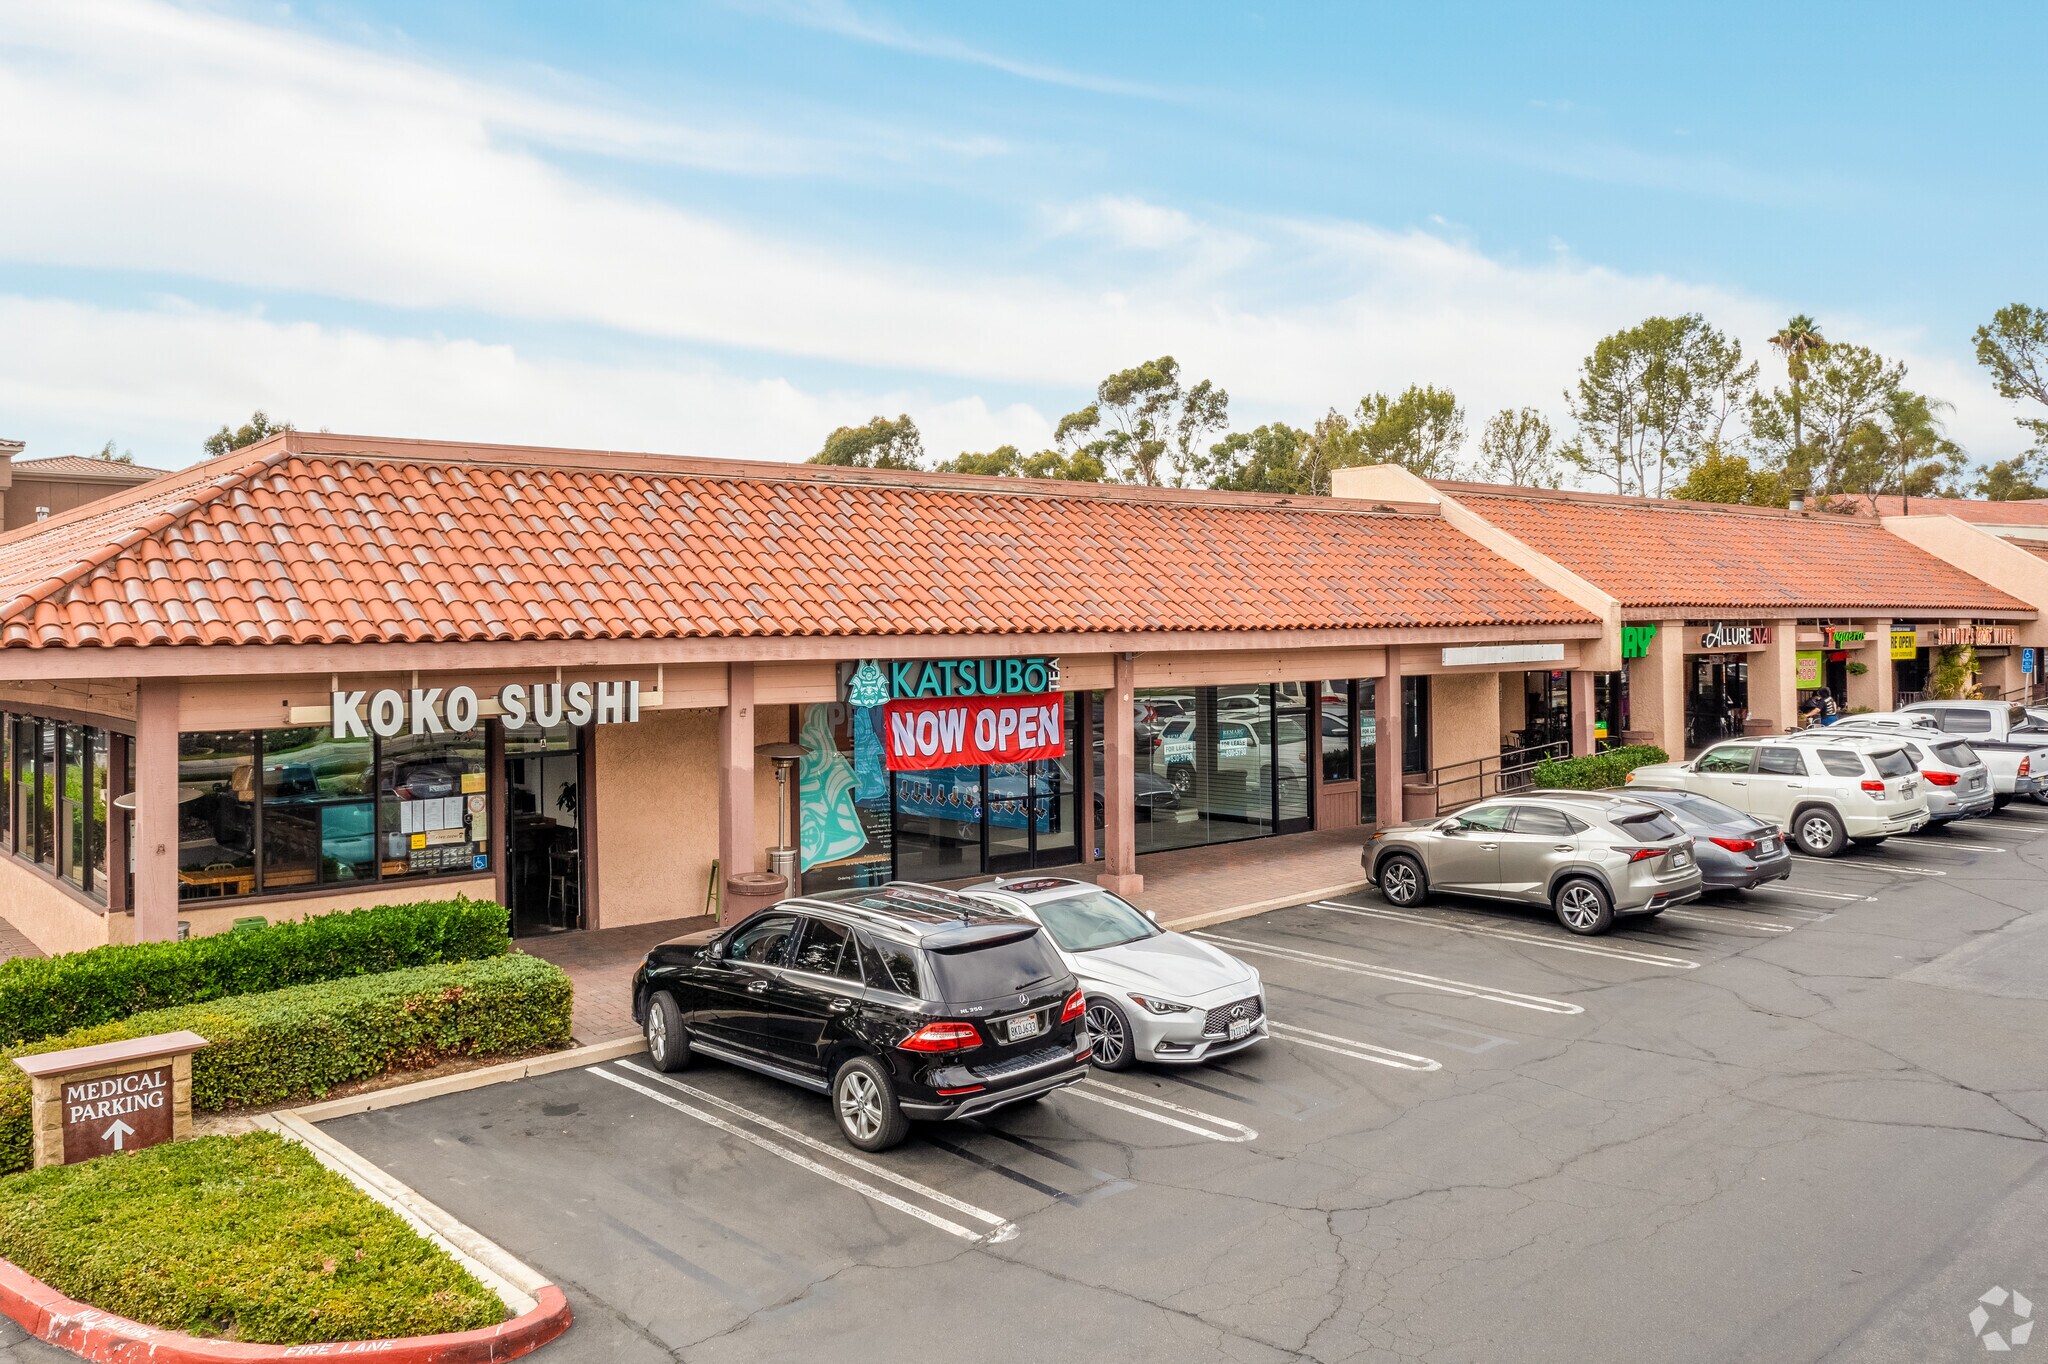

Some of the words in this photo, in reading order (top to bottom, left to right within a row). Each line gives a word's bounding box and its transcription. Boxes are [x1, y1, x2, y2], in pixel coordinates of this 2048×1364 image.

[1621, 624, 1657, 658] AY
[1703, 622, 1752, 648] ALLURE
[1048, 657, 1060, 692] TEA
[1798, 668, 1817, 680] FOOD
[332, 685, 479, 739] KOKO
[500, 680, 640, 730] SUSHI
[891, 707, 968, 757] NOW
[974, 703, 1060, 752] OPEN
[66, 1071, 167, 1104] MEDICAL
[70, 1090, 164, 1124] PARKING
[283, 1342, 336, 1357] FIRE
[339, 1340, 397, 1354] LANE
